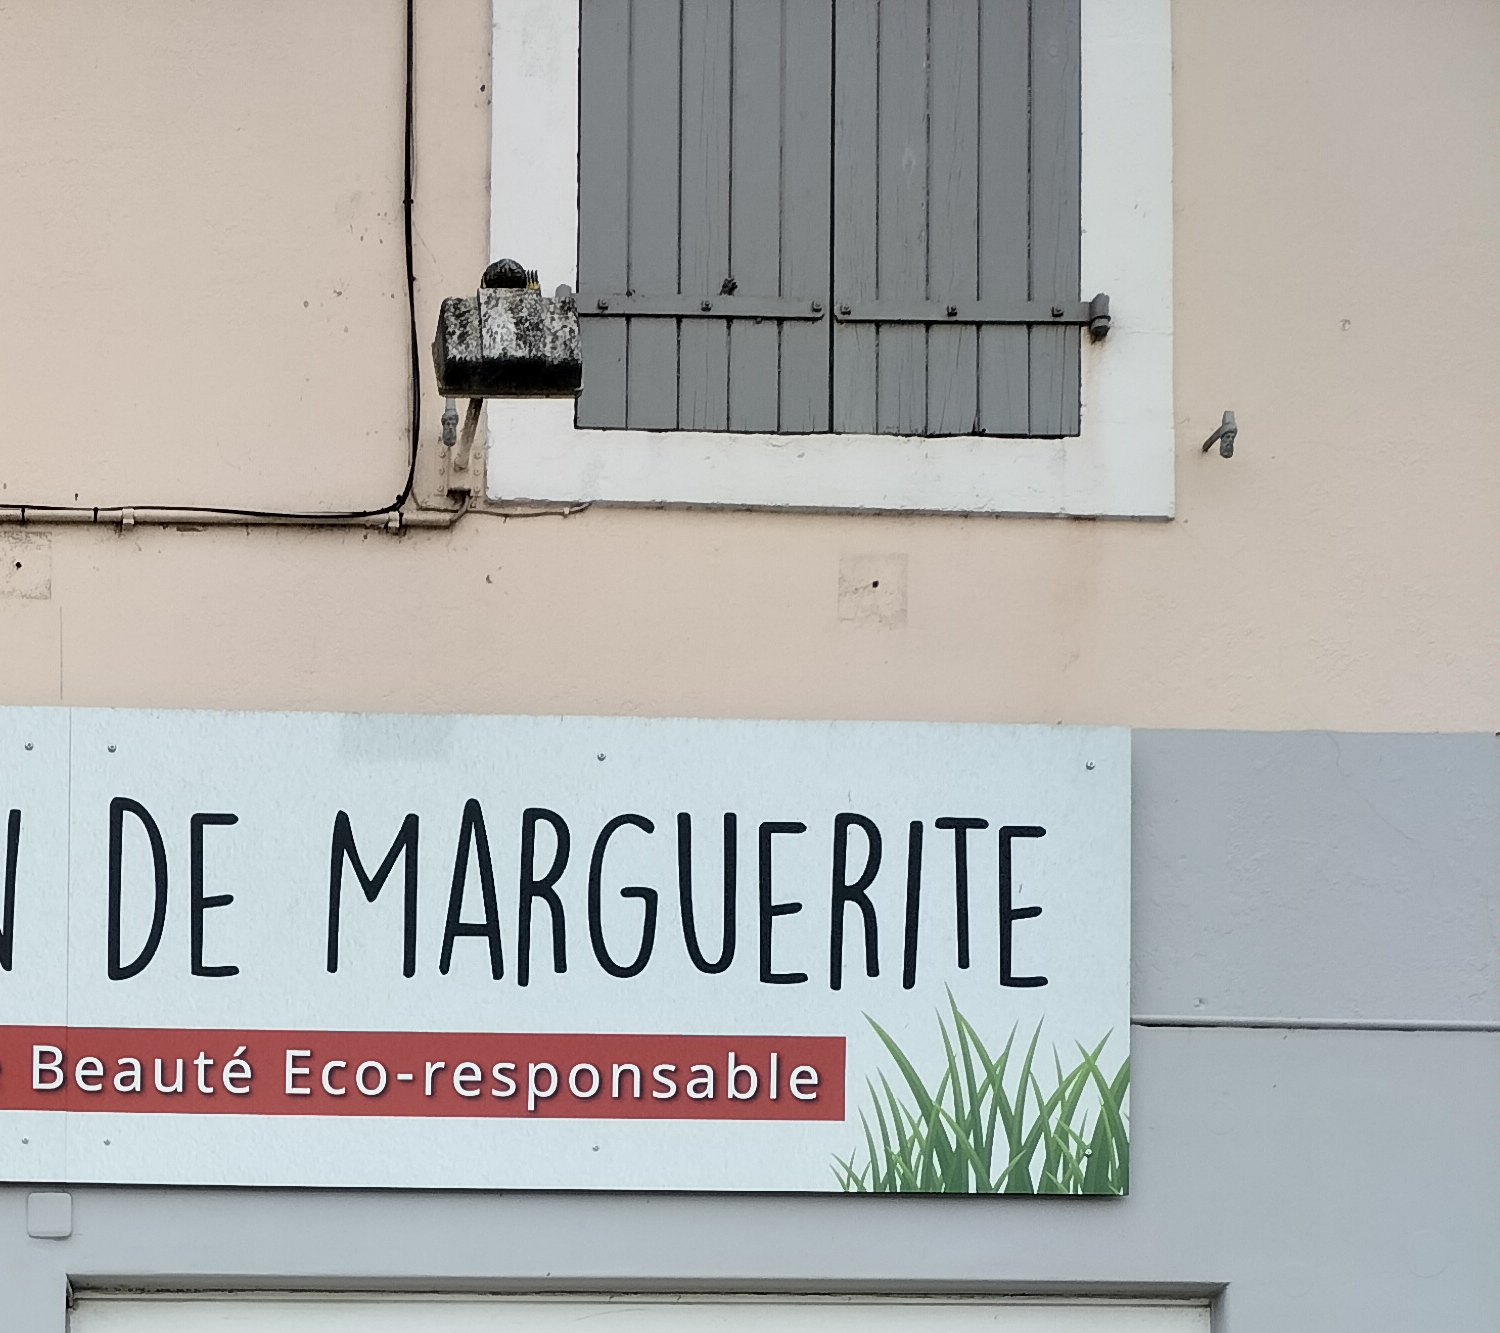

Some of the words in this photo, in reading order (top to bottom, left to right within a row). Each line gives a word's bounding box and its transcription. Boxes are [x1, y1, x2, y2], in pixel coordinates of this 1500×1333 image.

[107, 796, 239, 981] DE
[326, 798, 1049, 991] MARGUERITE
[31, 1045, 254, 1096] Beauté
[284, 1048, 820, 1112] Eco-responsable
